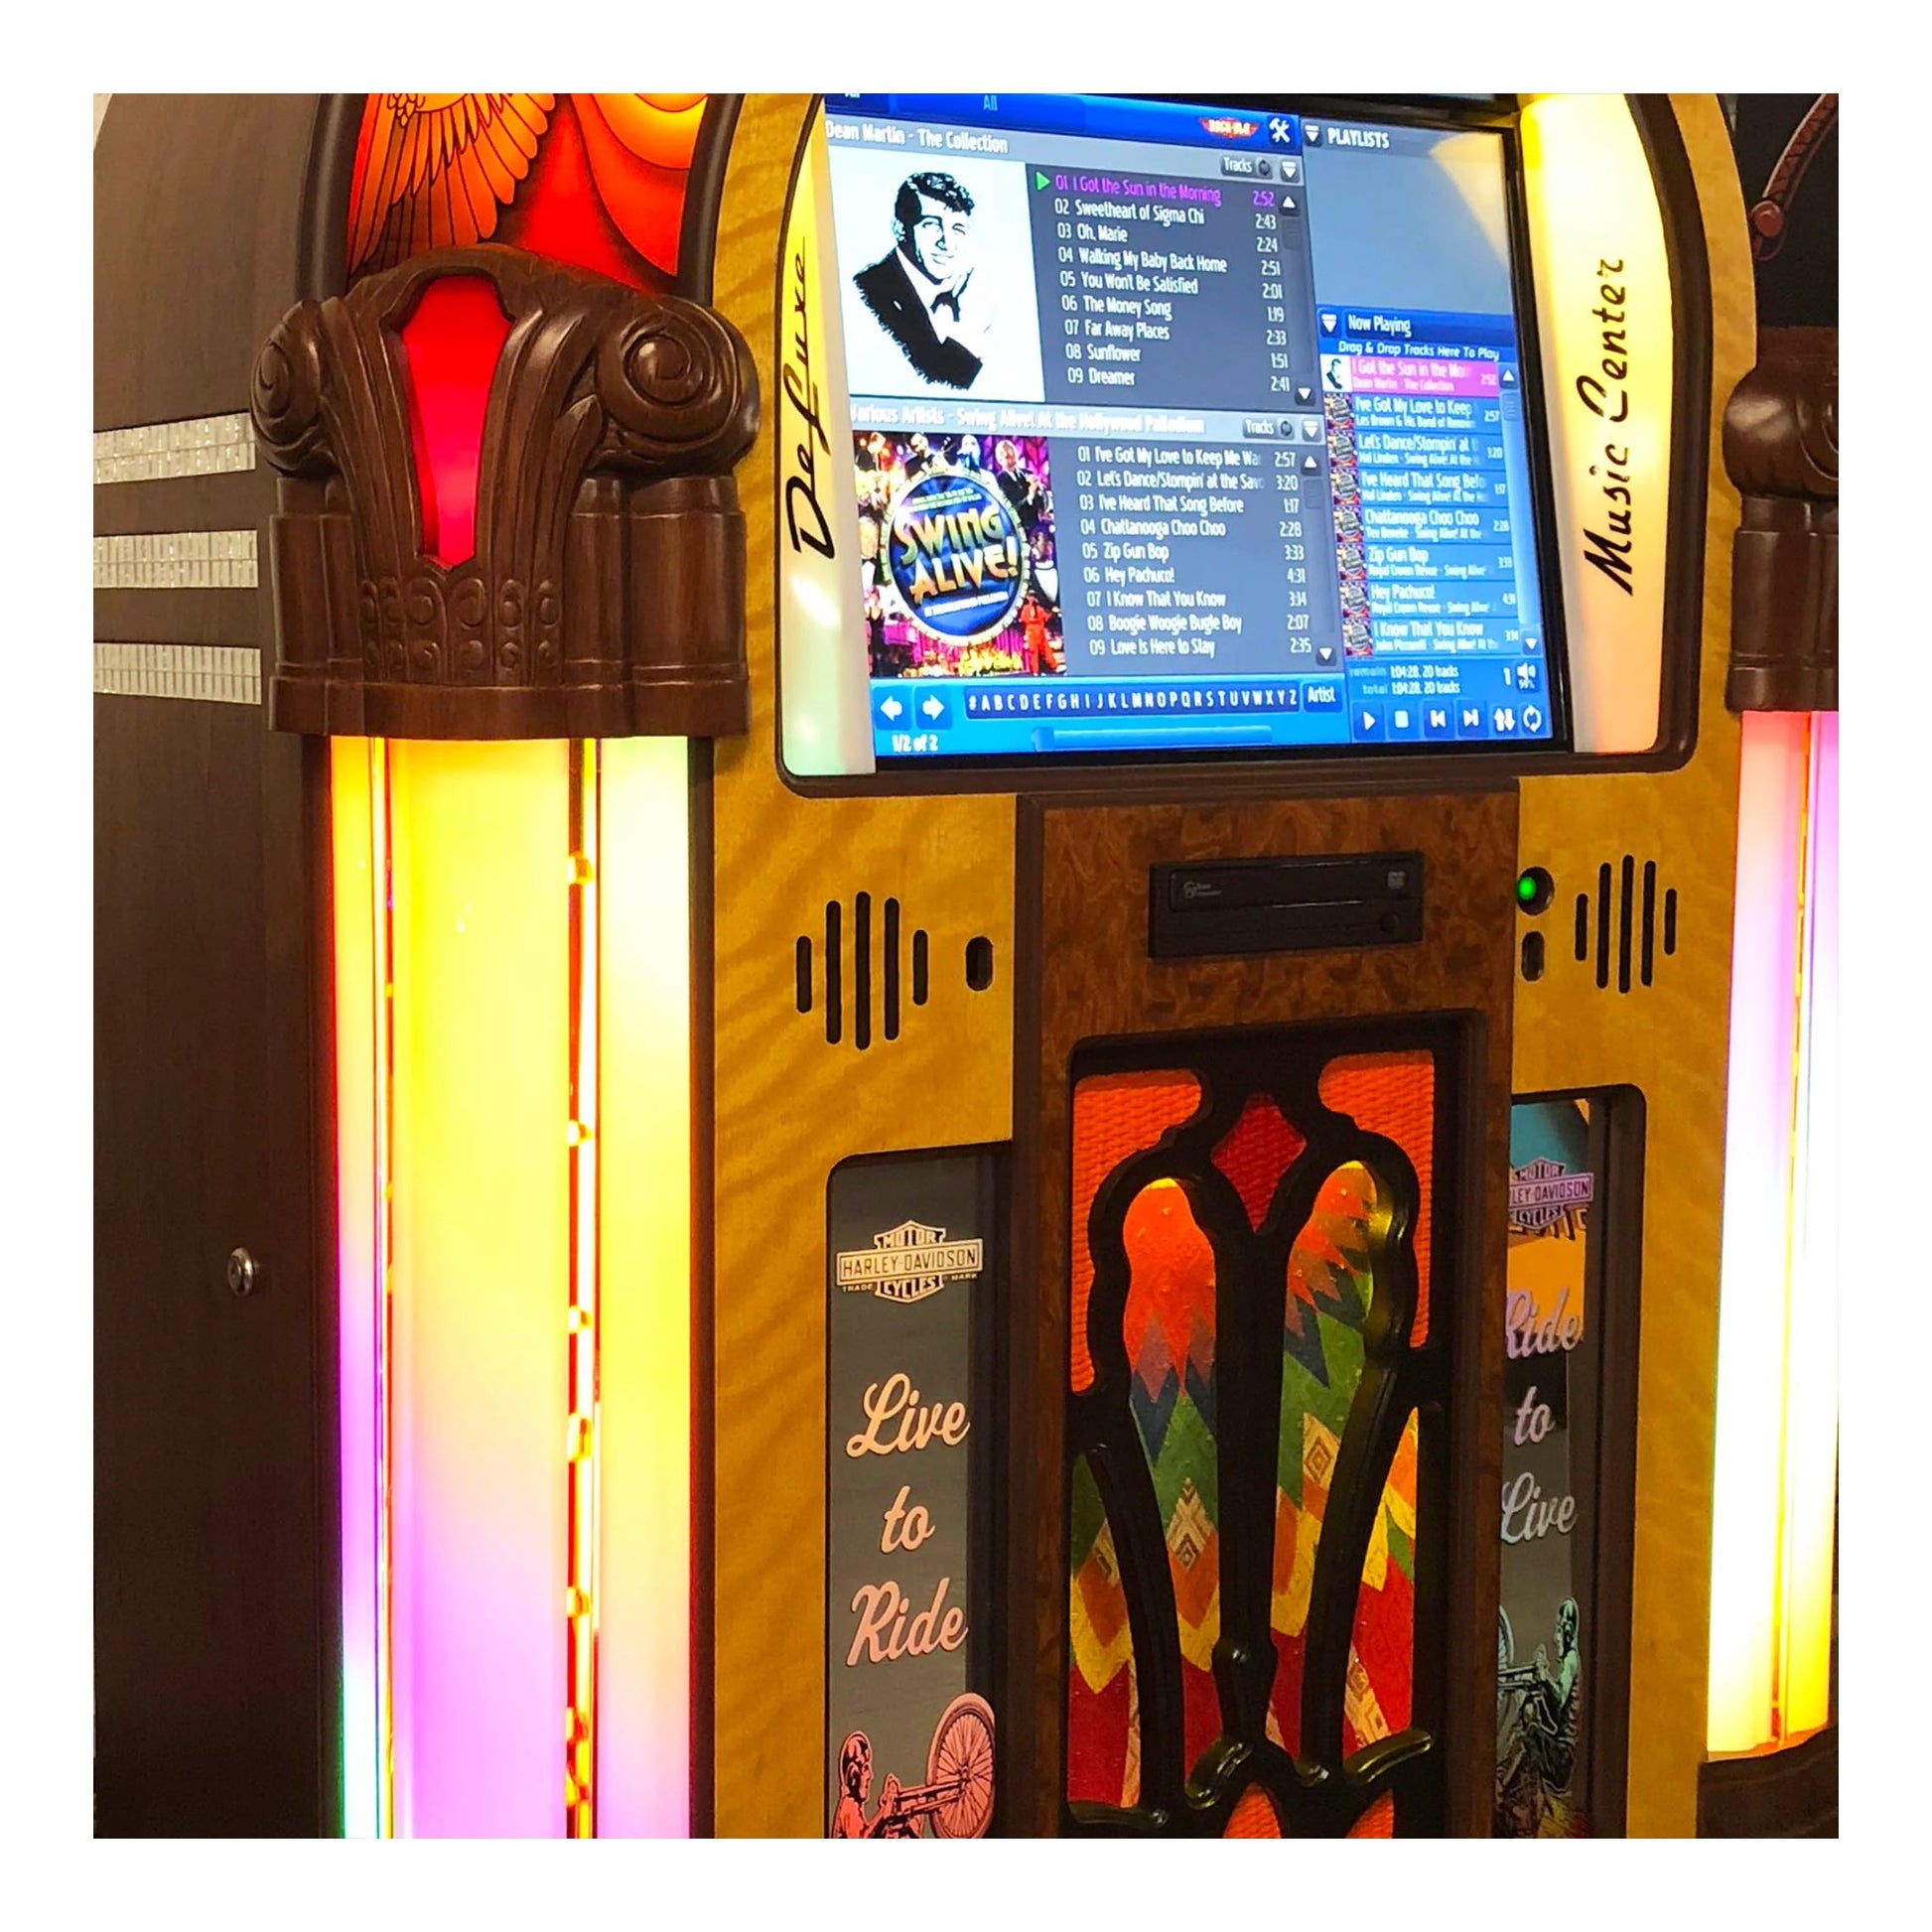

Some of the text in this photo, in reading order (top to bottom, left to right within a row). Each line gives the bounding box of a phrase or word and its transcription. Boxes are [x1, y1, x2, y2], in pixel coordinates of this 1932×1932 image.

[983, 94, 998, 111] All
[863, 123, 905, 145] Martin
[916, 128, 943, 149] The
[945, 131, 1009, 154] Collection
[1327, 128, 1389, 149] PLAYLISTS
[1222, 157, 1253, 174] Tracks
[1079, 177, 1100, 192] Got
[1102, 179, 1120, 195] the
[1124, 179, 1144, 196] Sun
[1146, 182, 1157, 197] in
[1160, 183, 1177, 199] the
[1179, 184, 1222, 207] Morning
[1054, 199, 1070, 214] 02
[1075, 199, 1137, 218] Sweetheart
[1139, 203, 1151, 218] of
[1153, 205, 1185, 227] Sigma
[1187, 207, 1205, 224] Chi
[1057, 222, 1072, 239] 03
[1098, 224, 1128, 243] Marie
[1057, 246, 1073, 263] 04
[1079, 247, 1123, 270] Walking
[1124, 250, 1141, 271] My
[1142, 251, 1168, 273] Baby
[1171, 253, 1196, 270] Back
[1197, 255, 1227, 273] Home
[1059, 271, 1076, 287] 05
[1081, 271, 1102, 289] You
[1136, 275, 1152, 291] Be
[1154, 276, 1198, 295] Satisfied
[1062, 295, 1078, 311] 06
[1083, 295, 1105, 313] The
[1106, 297, 1142, 319] Money
[1145, 299, 1173, 322] Song
[1064, 319, 1079, 335] 07
[1085, 319, 1102, 337] Far
[1105, 321, 1135, 343] Away
[1137, 322, 1171, 340] Places
[1348, 315, 1412, 338] Now Playing
[1065, 343, 1081, 359] 08
[1087, 344, 1142, 362] Sunflower
[1338, 341, 1363, 356] Drag
[1376, 343, 1401, 358] Drop
[1404, 344, 1435, 356] Tracks
[1438, 345, 1459, 357] Here
[1463, 345, 1475, 358] To
[1477, 346, 1500, 362] Play
[1067, 367, 1083, 383] 09
[1088, 367, 1136, 385] Dreamer
[1246, 419, 1275, 435] Tracks
[1576, 258, 1633, 598] Music Center
[1078, 446, 1090, 462] 01
[1115, 447, 1135, 464] Got
[1137, 448, 1153, 468] My
[1155, 448, 1179, 465] Love
[1181, 449, 1193, 465] to
[1195, 449, 1223, 471] Keep
[1224, 450, 1242, 466] Me
[1077, 471, 1092, 486] 02
[1206, 473, 1219, 487] at
[1220, 473, 1238, 488] the
[1079, 494, 1094, 511] 03
[1119, 495, 1151, 512] Heard
[1153, 495, 1177, 512] That
[1180, 496, 1208, 517] Song
[1209, 496, 1245, 513] Before
[1080, 518, 1096, 535] 04
[1100, 518, 1169, 540] Chattanooga
[1172, 519, 1198, 536] Choo
[1199, 520, 1226, 537] Choo
[1082, 542, 1098, 559] 05
[1103, 542, 1121, 563] Zip
[1123, 543, 1146, 559] Gun
[1148, 543, 1171, 564] Bop
[1083, 567, 1100, 583] 06
[1104, 567, 1126, 588] Hey
[1128, 567, 1175, 584] Pachuco!
[1086, 591, 1101, 607] 07
[1114, 591, 1145, 607] Know
[1147, 591, 1171, 607] That
[1173, 591, 1194, 607] You
[1196, 591, 1227, 607] Know
[1087, 616, 1104, 631] 08
[1108, 615, 1147, 635] Boogie
[1149, 615, 1187, 635] Woogie
[1189, 615, 1220, 635] Bugle
[1222, 615, 1242, 635] Boy
[1089, 638, 1105, 655] 09
[1110, 638, 1137, 655] Love
[1139, 638, 1148, 655] Is
[1150, 637, 1175, 654] Here
[1177, 637, 1189, 654] to
[1192, 637, 1215, 658] Stay
[1308, 686, 1336, 703] Artist
[913, 734, 927, 753] of
[929, 734, 938, 751] 2
[883, 1229, 938, 1249] MOTOR
[843, 1248, 977, 1278] HARLEY-DAVIDSON
[842, 1284, 874, 1293] TRADE
[883, 1276, 937, 1298] CYCLES
[846, 1373, 970, 1457] Live
[1514, 1386, 1556, 1446] to
[880, 1485, 935, 1553] to
[846, 1577, 968, 1666] Ride
